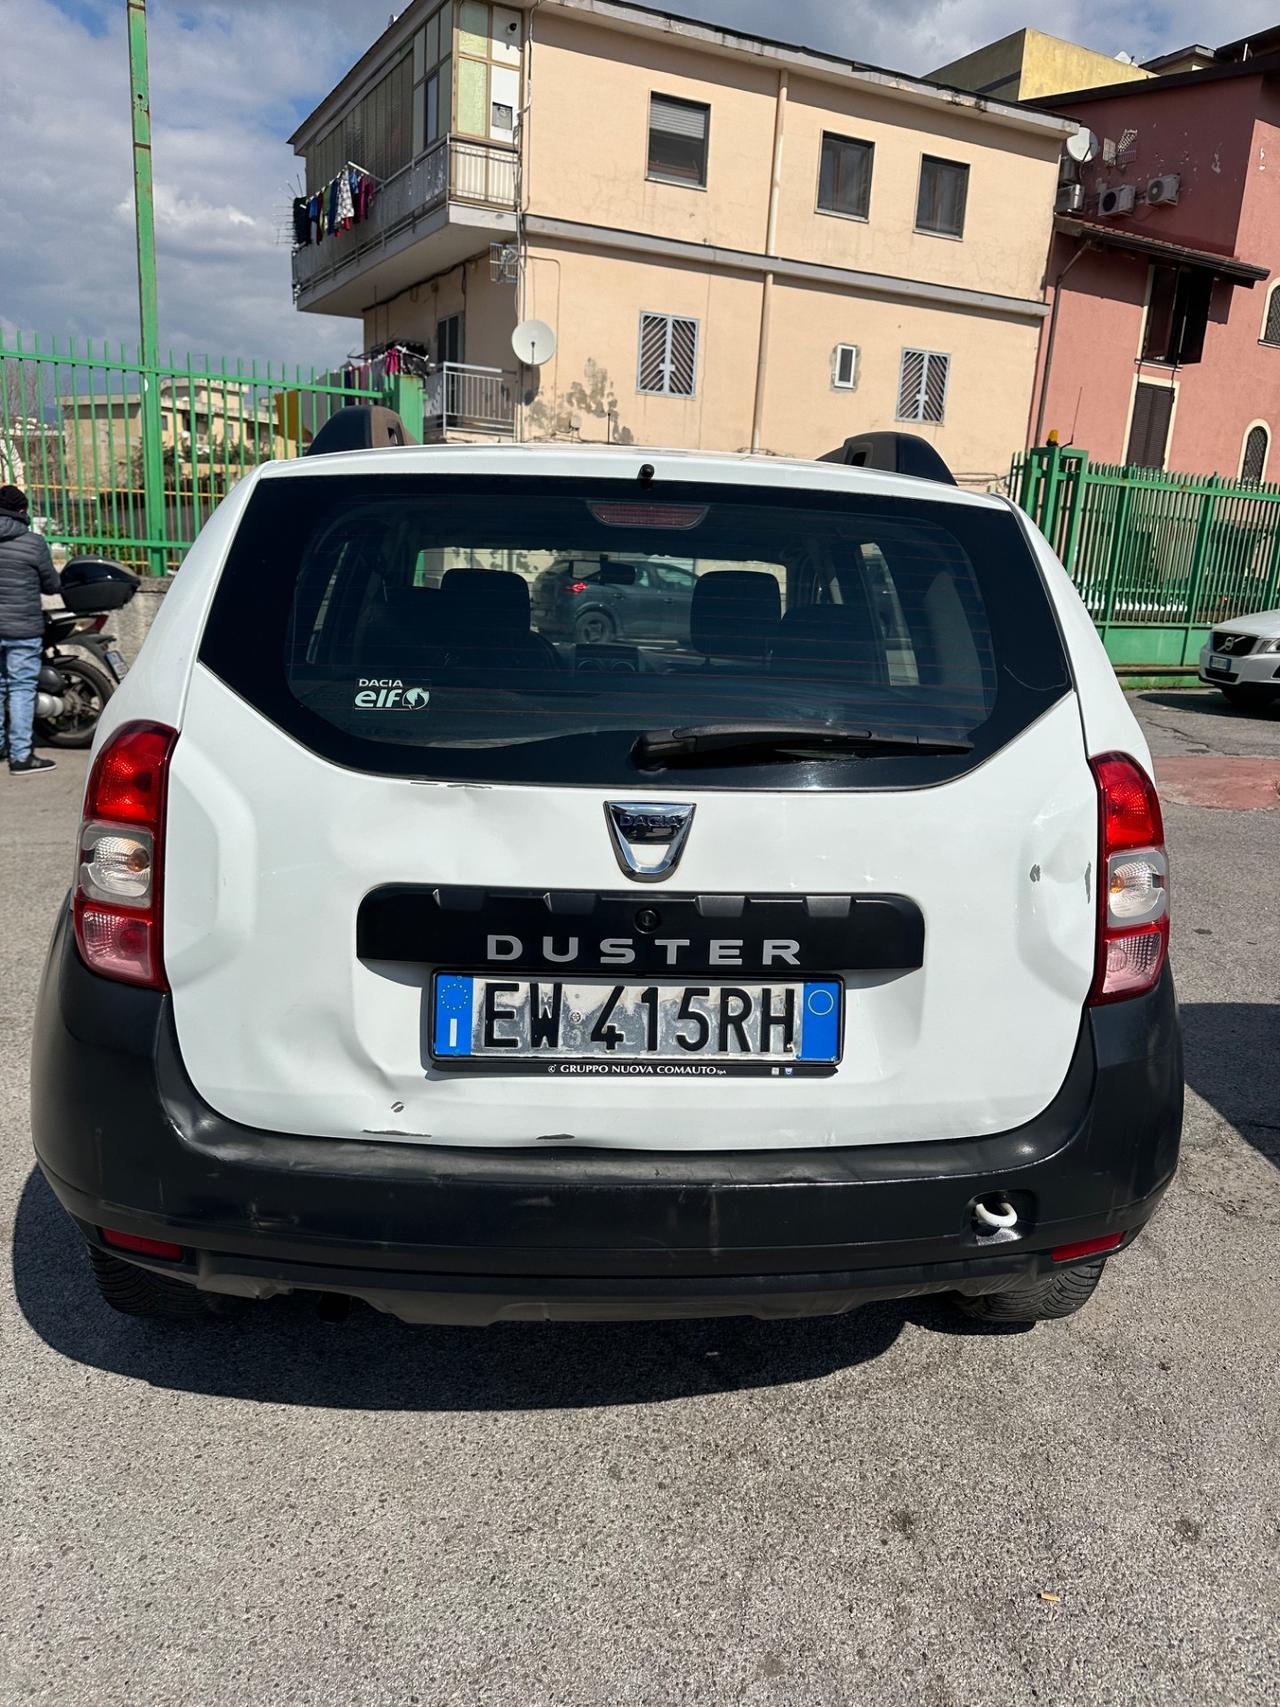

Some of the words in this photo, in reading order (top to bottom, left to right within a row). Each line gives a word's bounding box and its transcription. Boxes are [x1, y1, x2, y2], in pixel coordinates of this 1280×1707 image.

[358, 678, 403, 687] DACIA
[354, 689, 403, 708] elf
[486, 934, 801, 966] DUSTER
[484, 982, 563, 1048] EW
[591, 985, 796, 1053] 415RH
[560, 1064, 609, 1074] GRUPPO
[611, 1064, 653, 1075] NUOVA
[656, 1065, 717, 1075] COMAUTO
